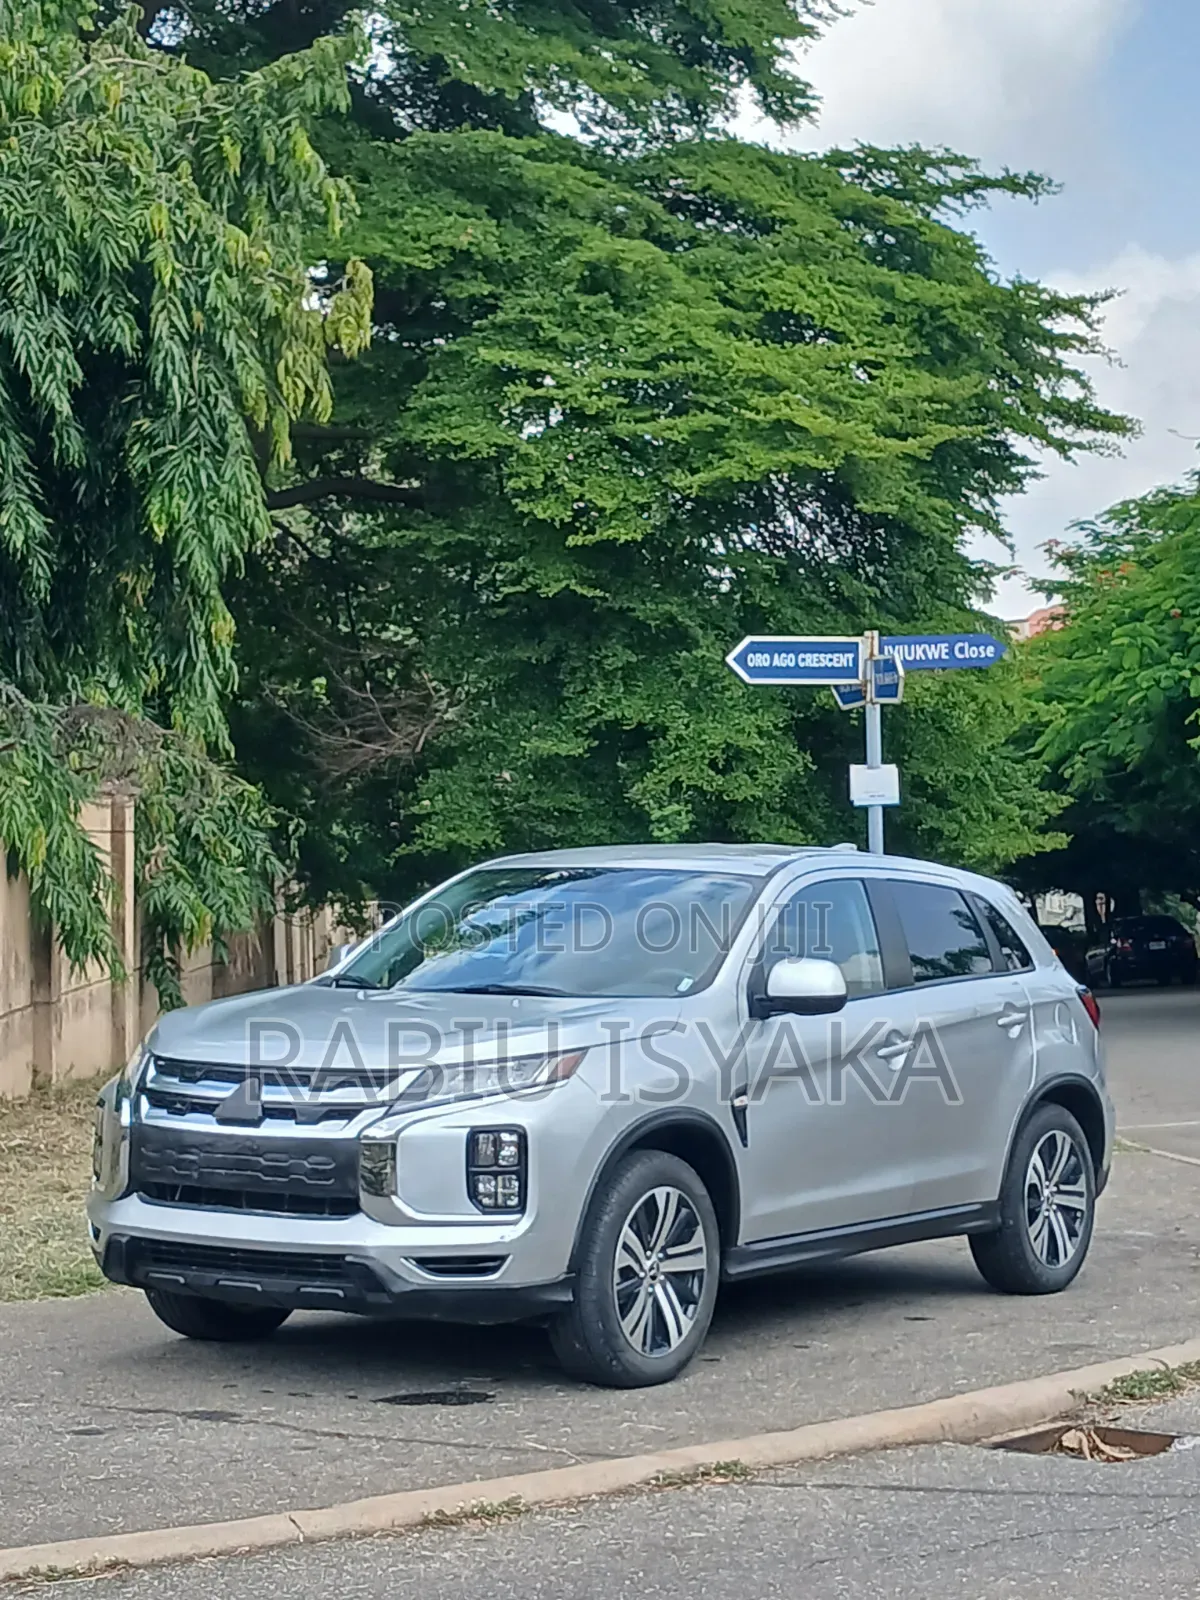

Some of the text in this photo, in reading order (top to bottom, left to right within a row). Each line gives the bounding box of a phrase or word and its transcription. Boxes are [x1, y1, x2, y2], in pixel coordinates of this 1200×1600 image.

[954, 641, 995, 659] Close
[747, 653, 855, 667] ORO AGO CRESCENT
